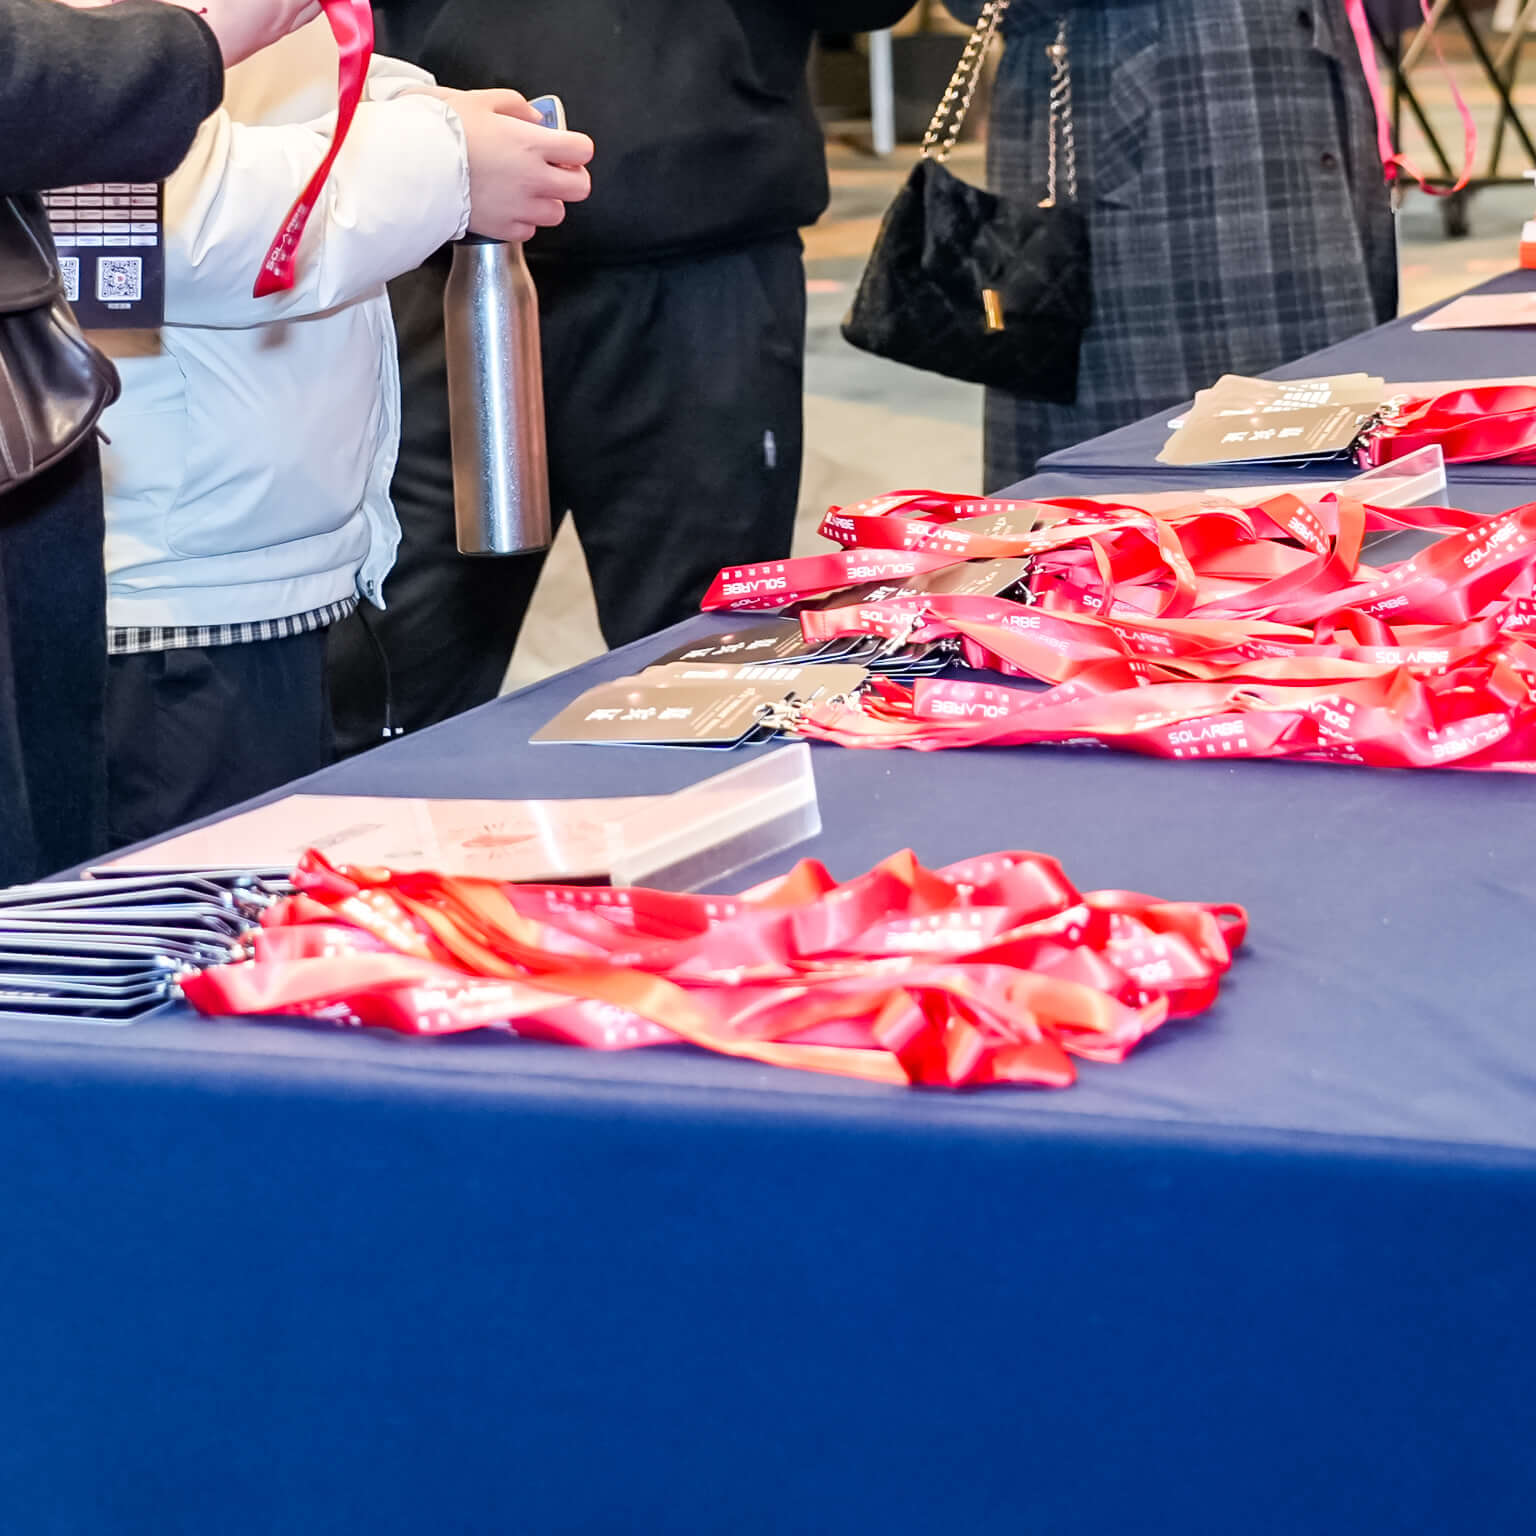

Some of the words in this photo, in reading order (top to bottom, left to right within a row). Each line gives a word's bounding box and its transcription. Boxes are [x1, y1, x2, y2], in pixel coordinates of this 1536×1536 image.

[905, 522, 972, 543] SOLARBE
[1464, 520, 1516, 569] SOLARBE
[723, 576, 787, 596] SOLARBE
[931, 700, 1009, 718] SOLARBE
[1167, 719, 1245, 745] SOLARBE
